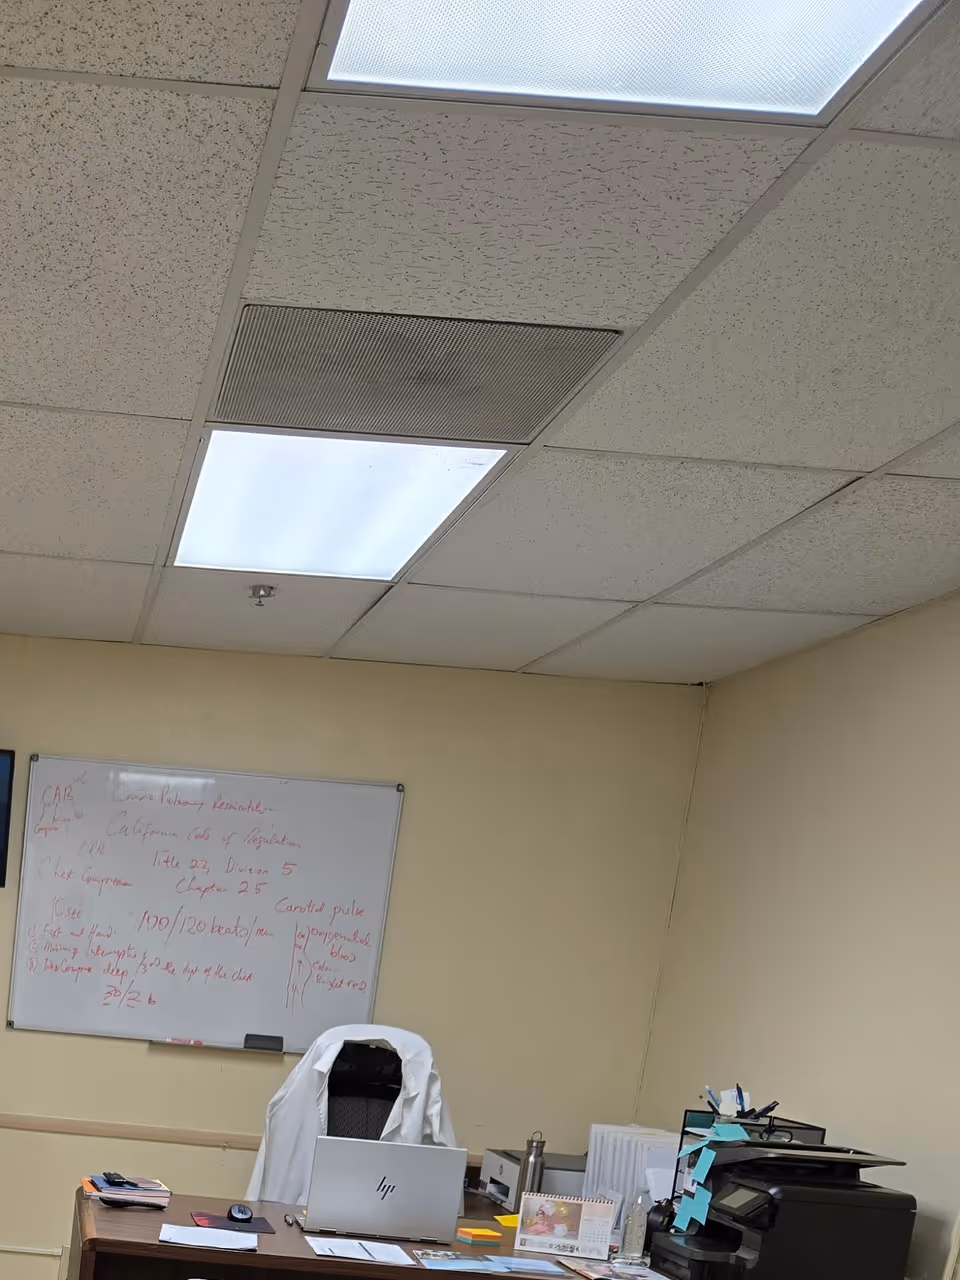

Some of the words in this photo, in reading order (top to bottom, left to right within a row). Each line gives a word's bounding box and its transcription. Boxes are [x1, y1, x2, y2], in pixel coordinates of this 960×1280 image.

[225, 856, 269, 875] Division
[281, 861, 297, 876] 5
[175, 875, 229, 900] Chapter
[329, 897, 365, 926] pulse
[376, 1175, 397, 1201] hp
